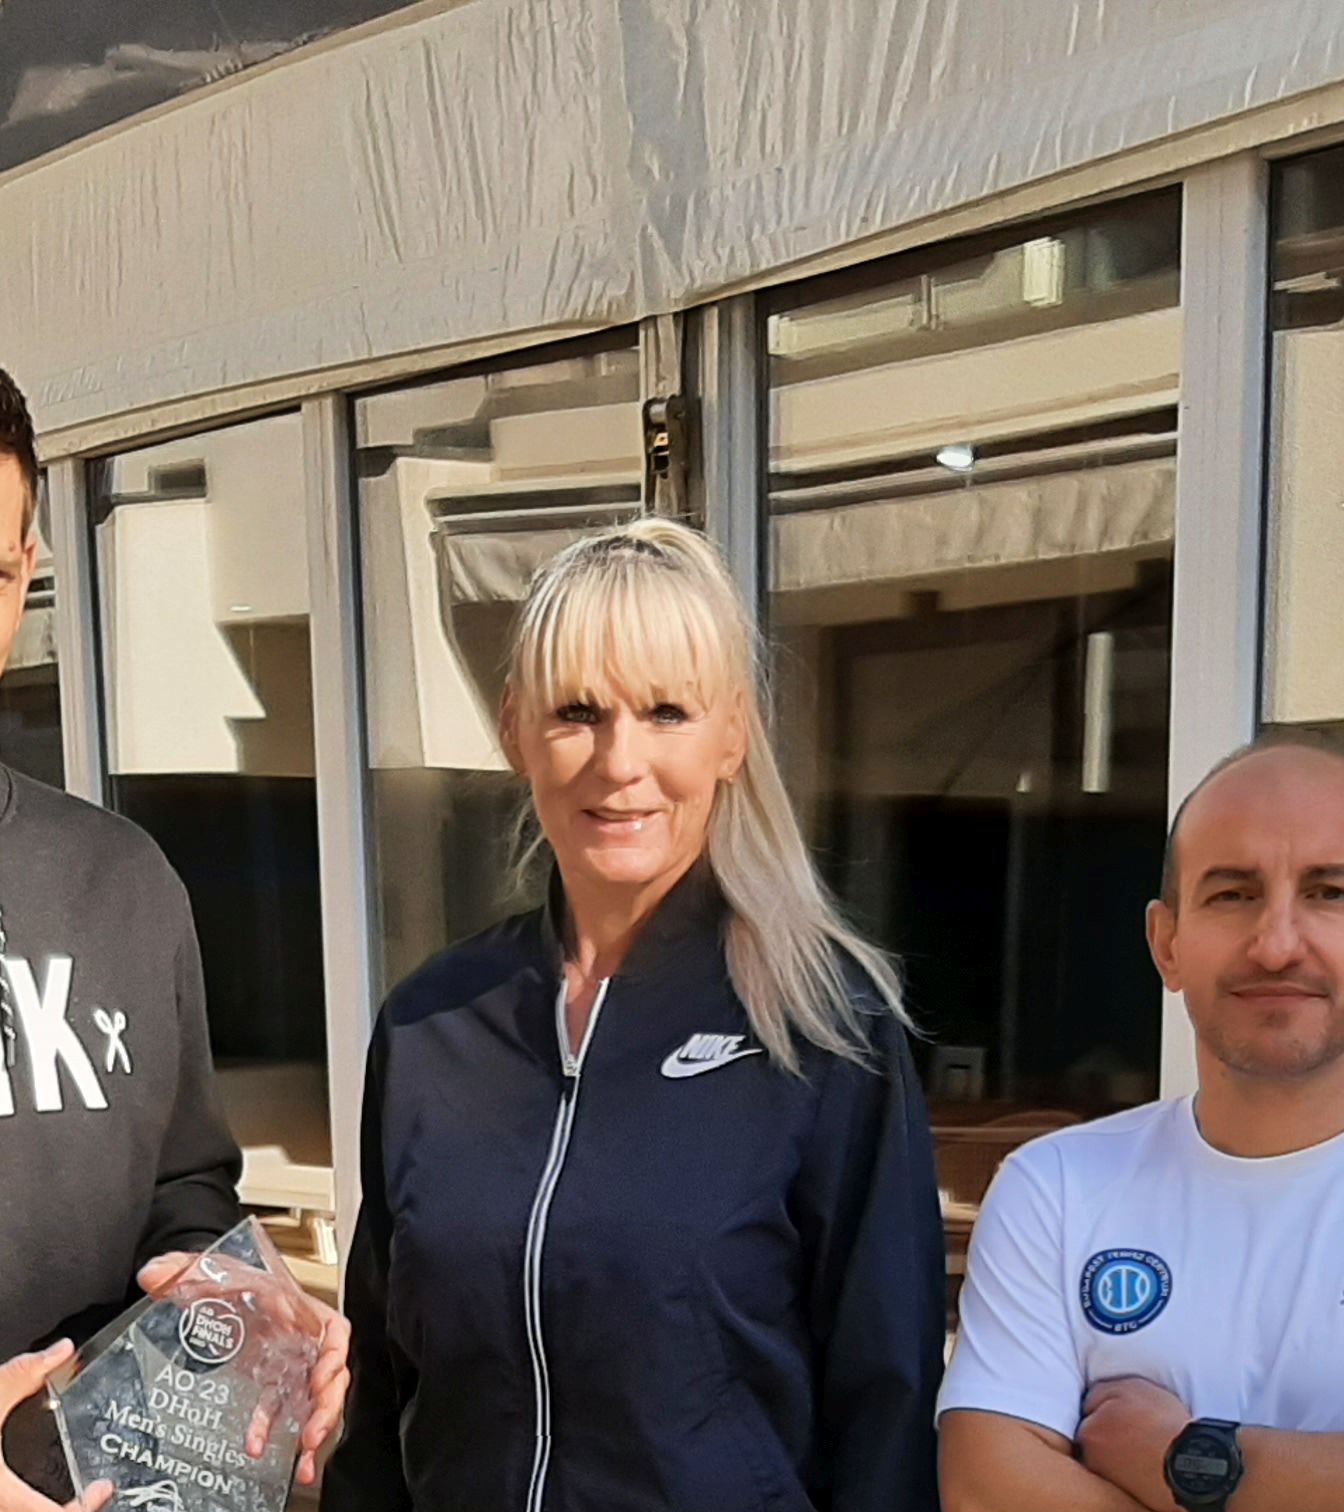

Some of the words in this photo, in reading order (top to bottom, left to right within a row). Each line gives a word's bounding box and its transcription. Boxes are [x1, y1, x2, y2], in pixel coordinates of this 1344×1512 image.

[679, 1033, 746, 1060] NIKE
[155, 1364, 195, 1391] AO
[199, 1380, 230, 1404] 23
[148, 1387, 223, 1430] DHoH
[105, 1400, 168, 1438] Men's
[171, 1424, 247, 1467] Singles
[100, 1433, 233, 1494] CHAMPION
